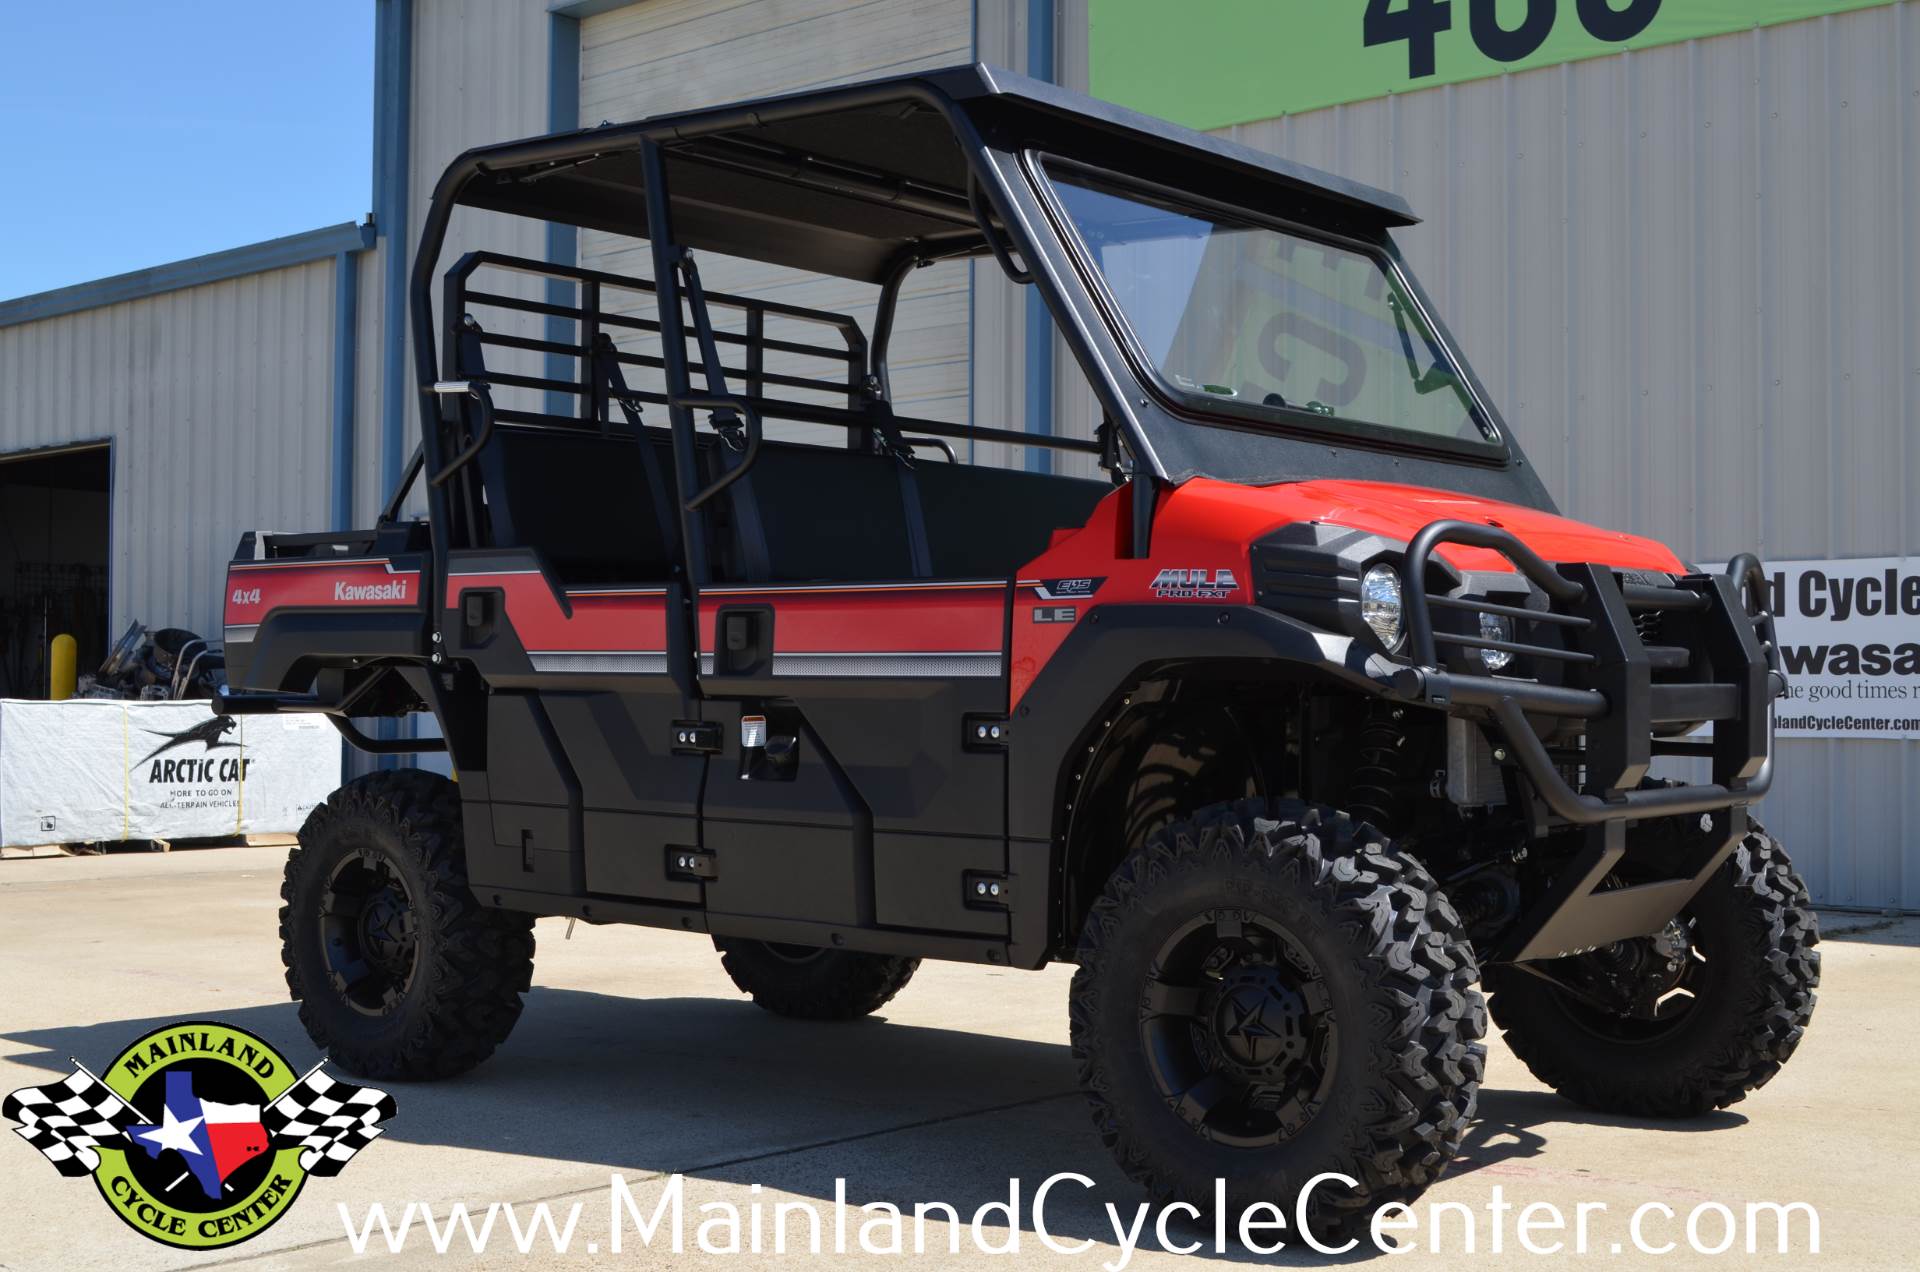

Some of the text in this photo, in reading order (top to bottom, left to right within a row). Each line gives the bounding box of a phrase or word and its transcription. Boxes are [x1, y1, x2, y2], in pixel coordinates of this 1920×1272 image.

[1150, 569, 1239, 589] MULE
[232, 588, 261, 604] 4x4
[334, 580, 407, 601] Kawasaki
[1157, 589, 1231, 599] PRO-FXT
[1799, 569, 1920, 621] Cycle
[1033, 607, 1076, 622] LE
[1779, 643, 1920, 675] wasa
[1808, 680, 1852, 702] good
[1857, 680, 1907, 698] times
[219, 758, 250, 782] CAT
[195, 789, 206, 797] TO
[208, 789, 219, 797] GO
[221, 788, 232, 796] ON
